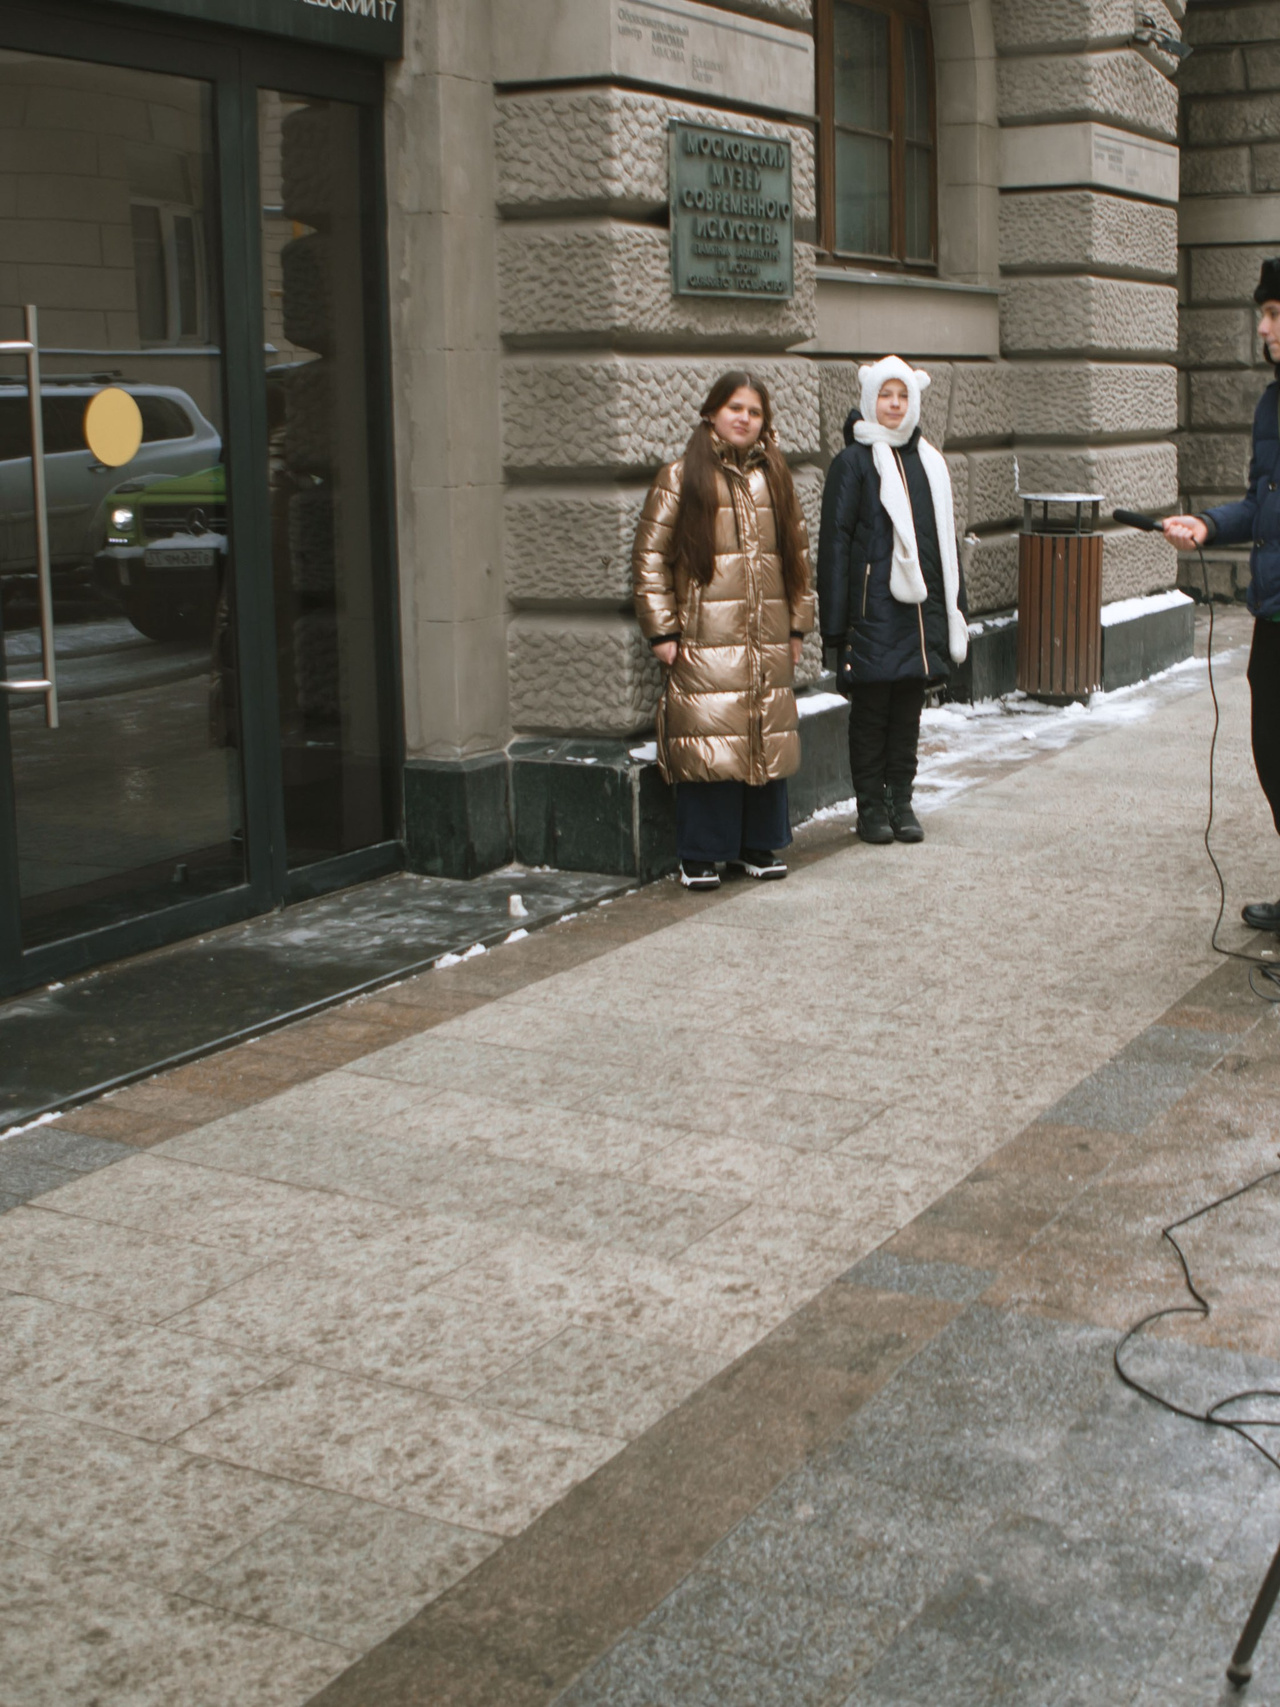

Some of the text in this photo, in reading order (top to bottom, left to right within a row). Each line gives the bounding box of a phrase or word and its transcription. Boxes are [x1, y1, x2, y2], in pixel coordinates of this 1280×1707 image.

[380, 0, 397, 22] 17
[686, 131, 785, 169] МОСКОВСКИЙ
[711, 162, 761, 191] МУЗЕЙ
[683, 187, 791, 219] СОВРЕМЕННОГО
[695, 217, 779, 244] ИСКУССТВА
